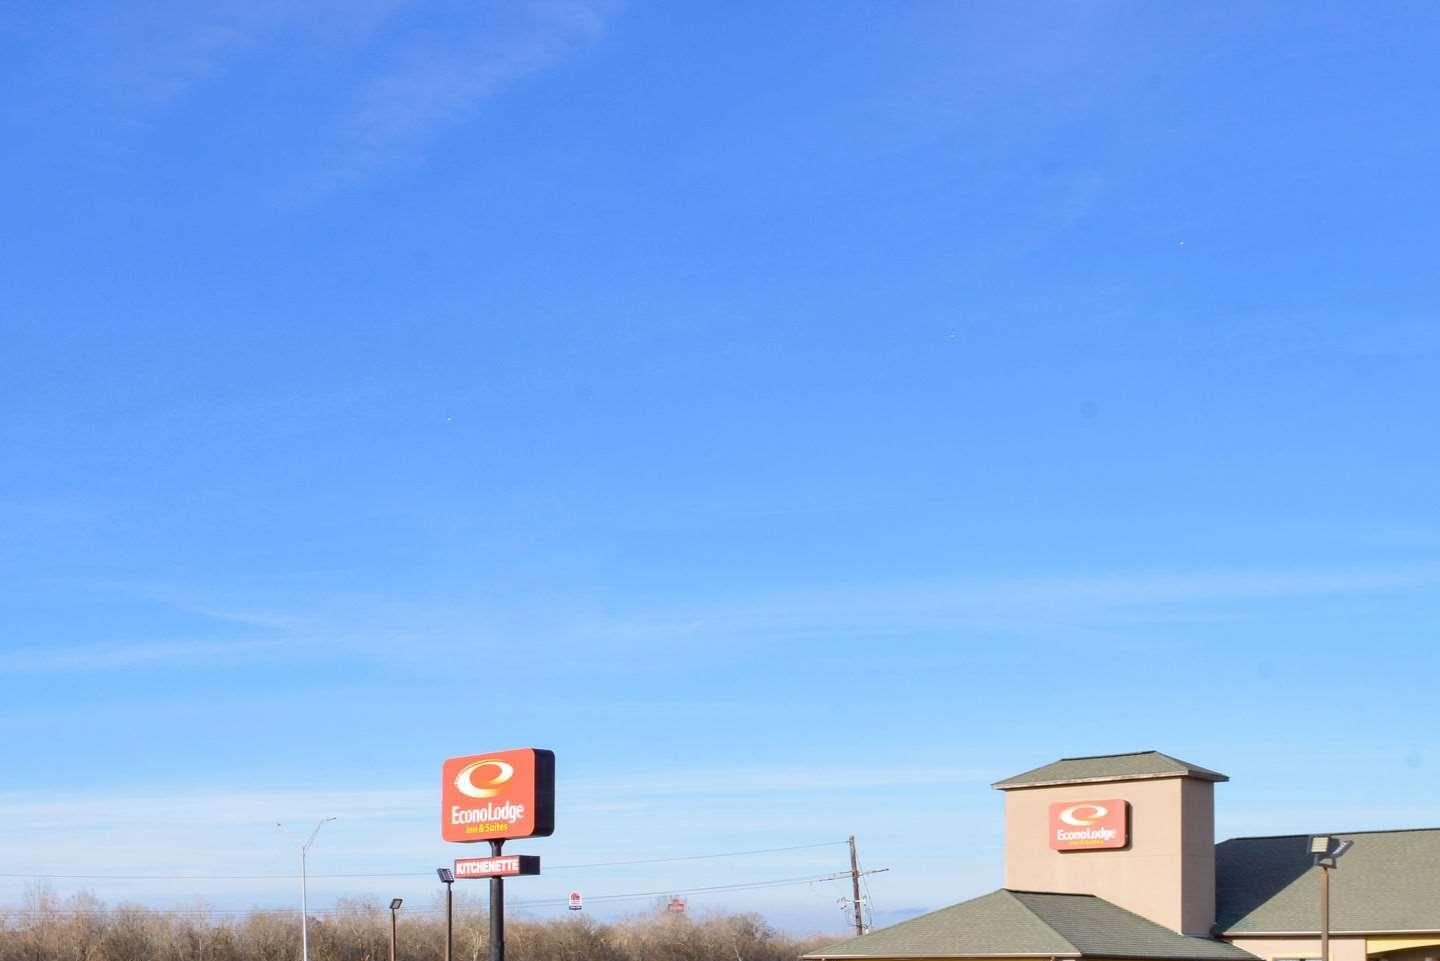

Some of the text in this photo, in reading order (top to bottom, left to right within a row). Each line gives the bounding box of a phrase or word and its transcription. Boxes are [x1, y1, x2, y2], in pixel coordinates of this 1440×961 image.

[451, 801, 524, 824] EconoLodge
[465, 822, 508, 834] Inn & Suites
[1056, 827, 1116, 841] EconoLodge
